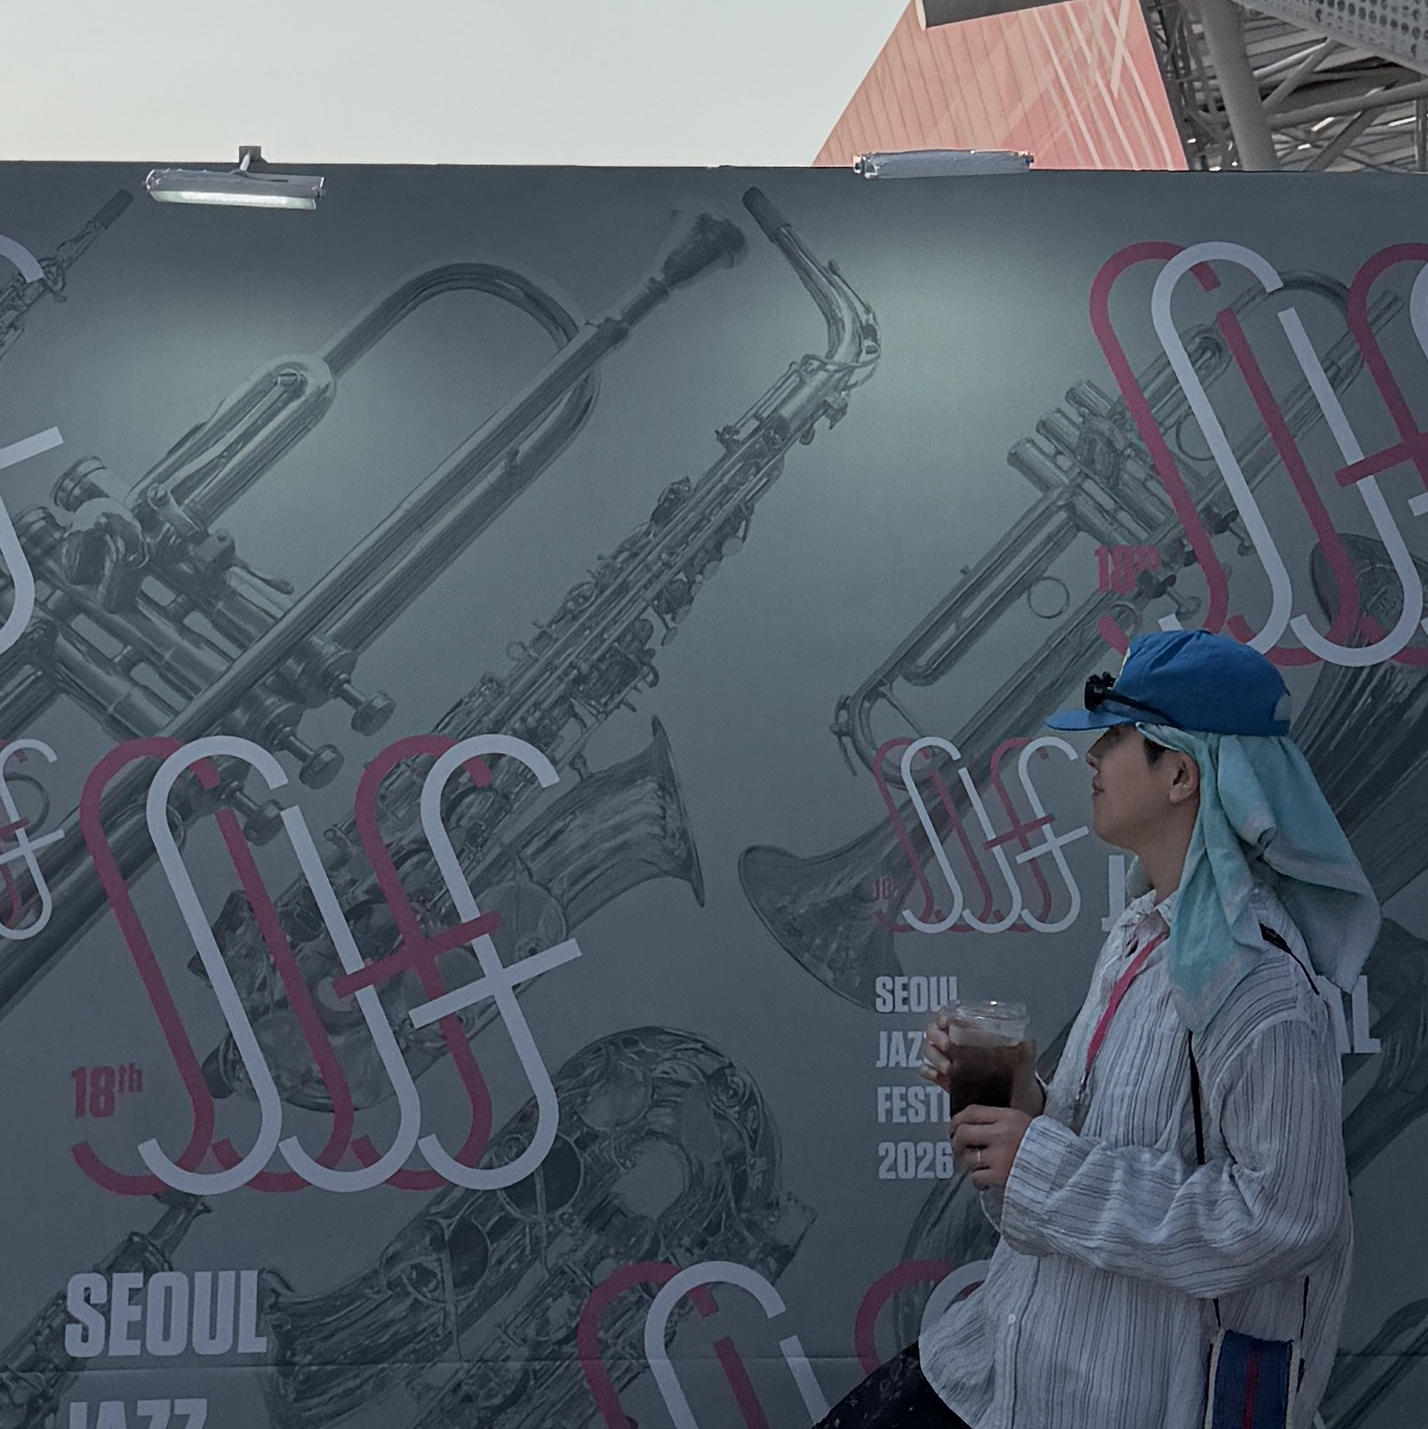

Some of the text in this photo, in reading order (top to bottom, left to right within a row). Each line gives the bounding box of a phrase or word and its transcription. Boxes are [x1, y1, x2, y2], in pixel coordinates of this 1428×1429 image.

[876, 1030, 927, 1068] JAZ
[73, 1063, 143, 1119] 18th
[877, 1086, 951, 1123] FESTI
[878, 1141, 954, 1180] 2026
[64, 1269, 268, 1358] SEOUL
